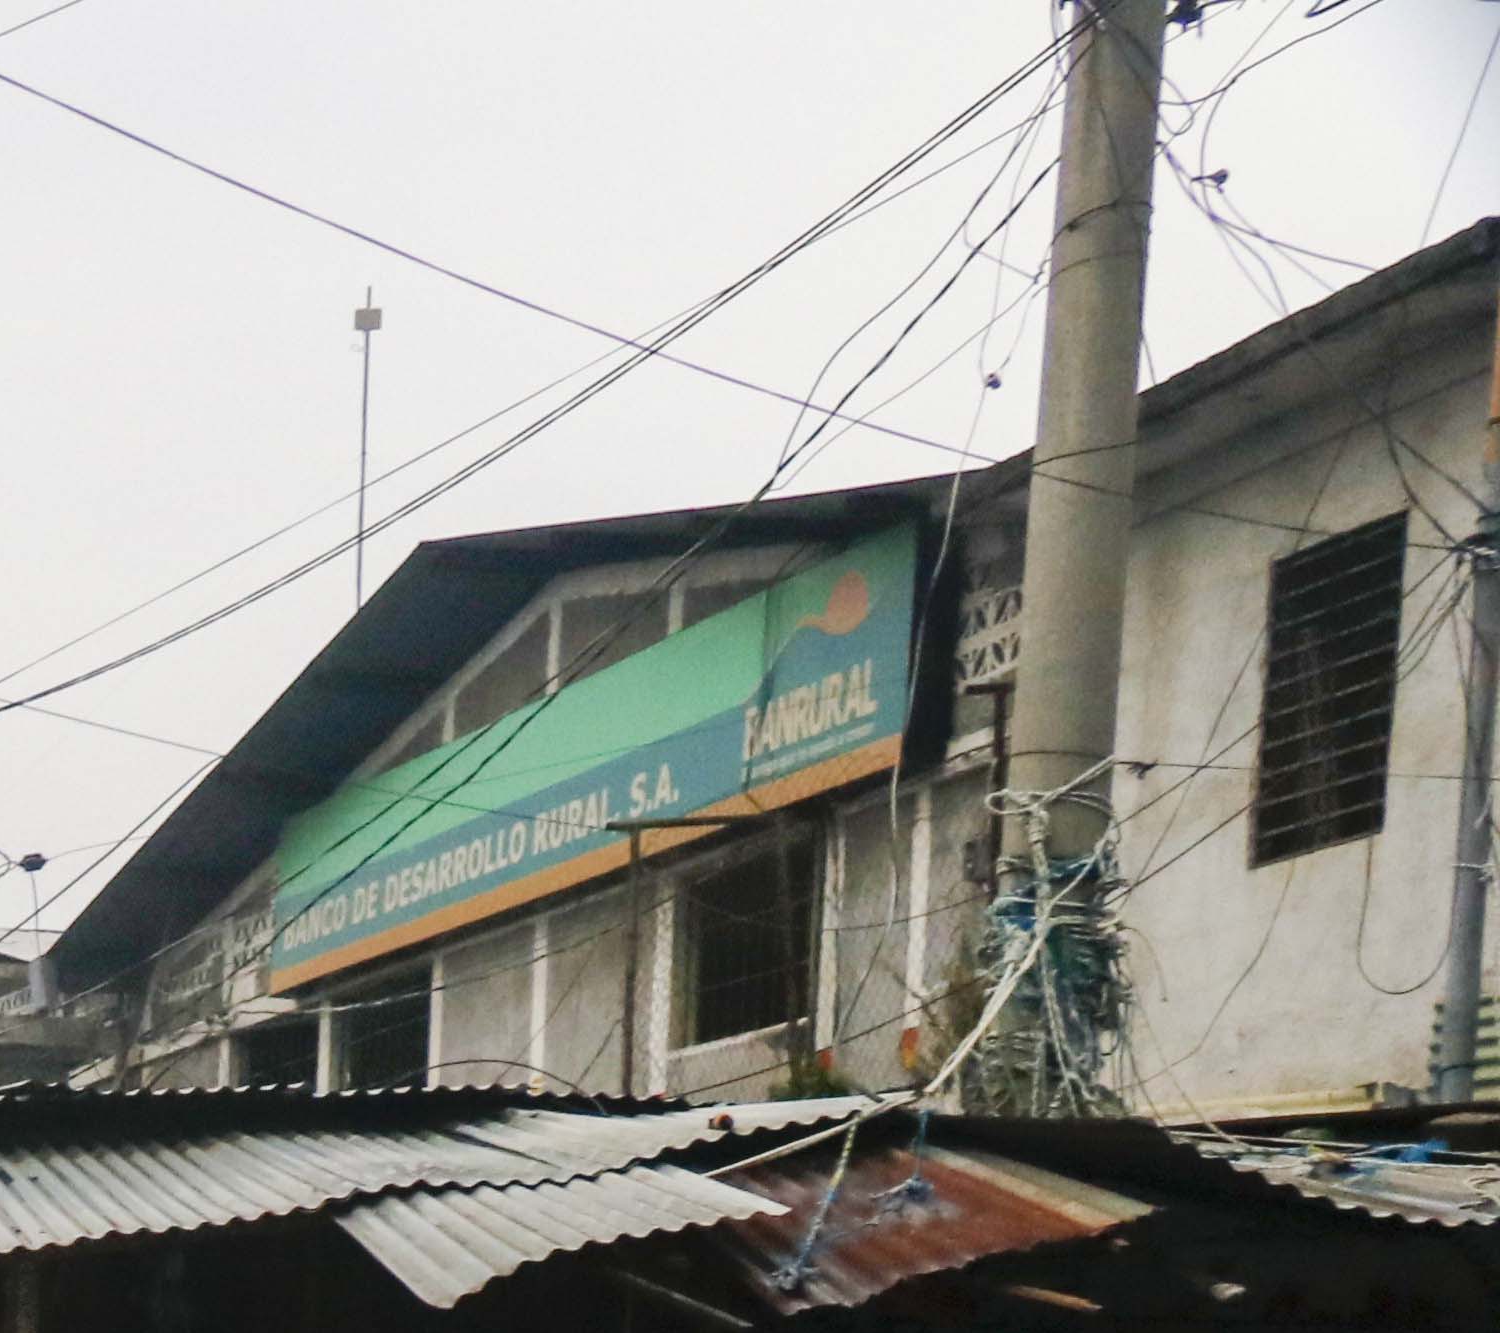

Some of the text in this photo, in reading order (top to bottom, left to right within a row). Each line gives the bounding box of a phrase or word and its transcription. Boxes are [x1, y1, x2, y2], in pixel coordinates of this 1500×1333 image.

[743, 658, 879, 761] BANRURAL
[282, 893, 348, 953] BANCO
[351, 881, 380, 926] DE
[383, 820, 528, 914] DESARROLLO
[628, 762, 681, 820] S.A.
